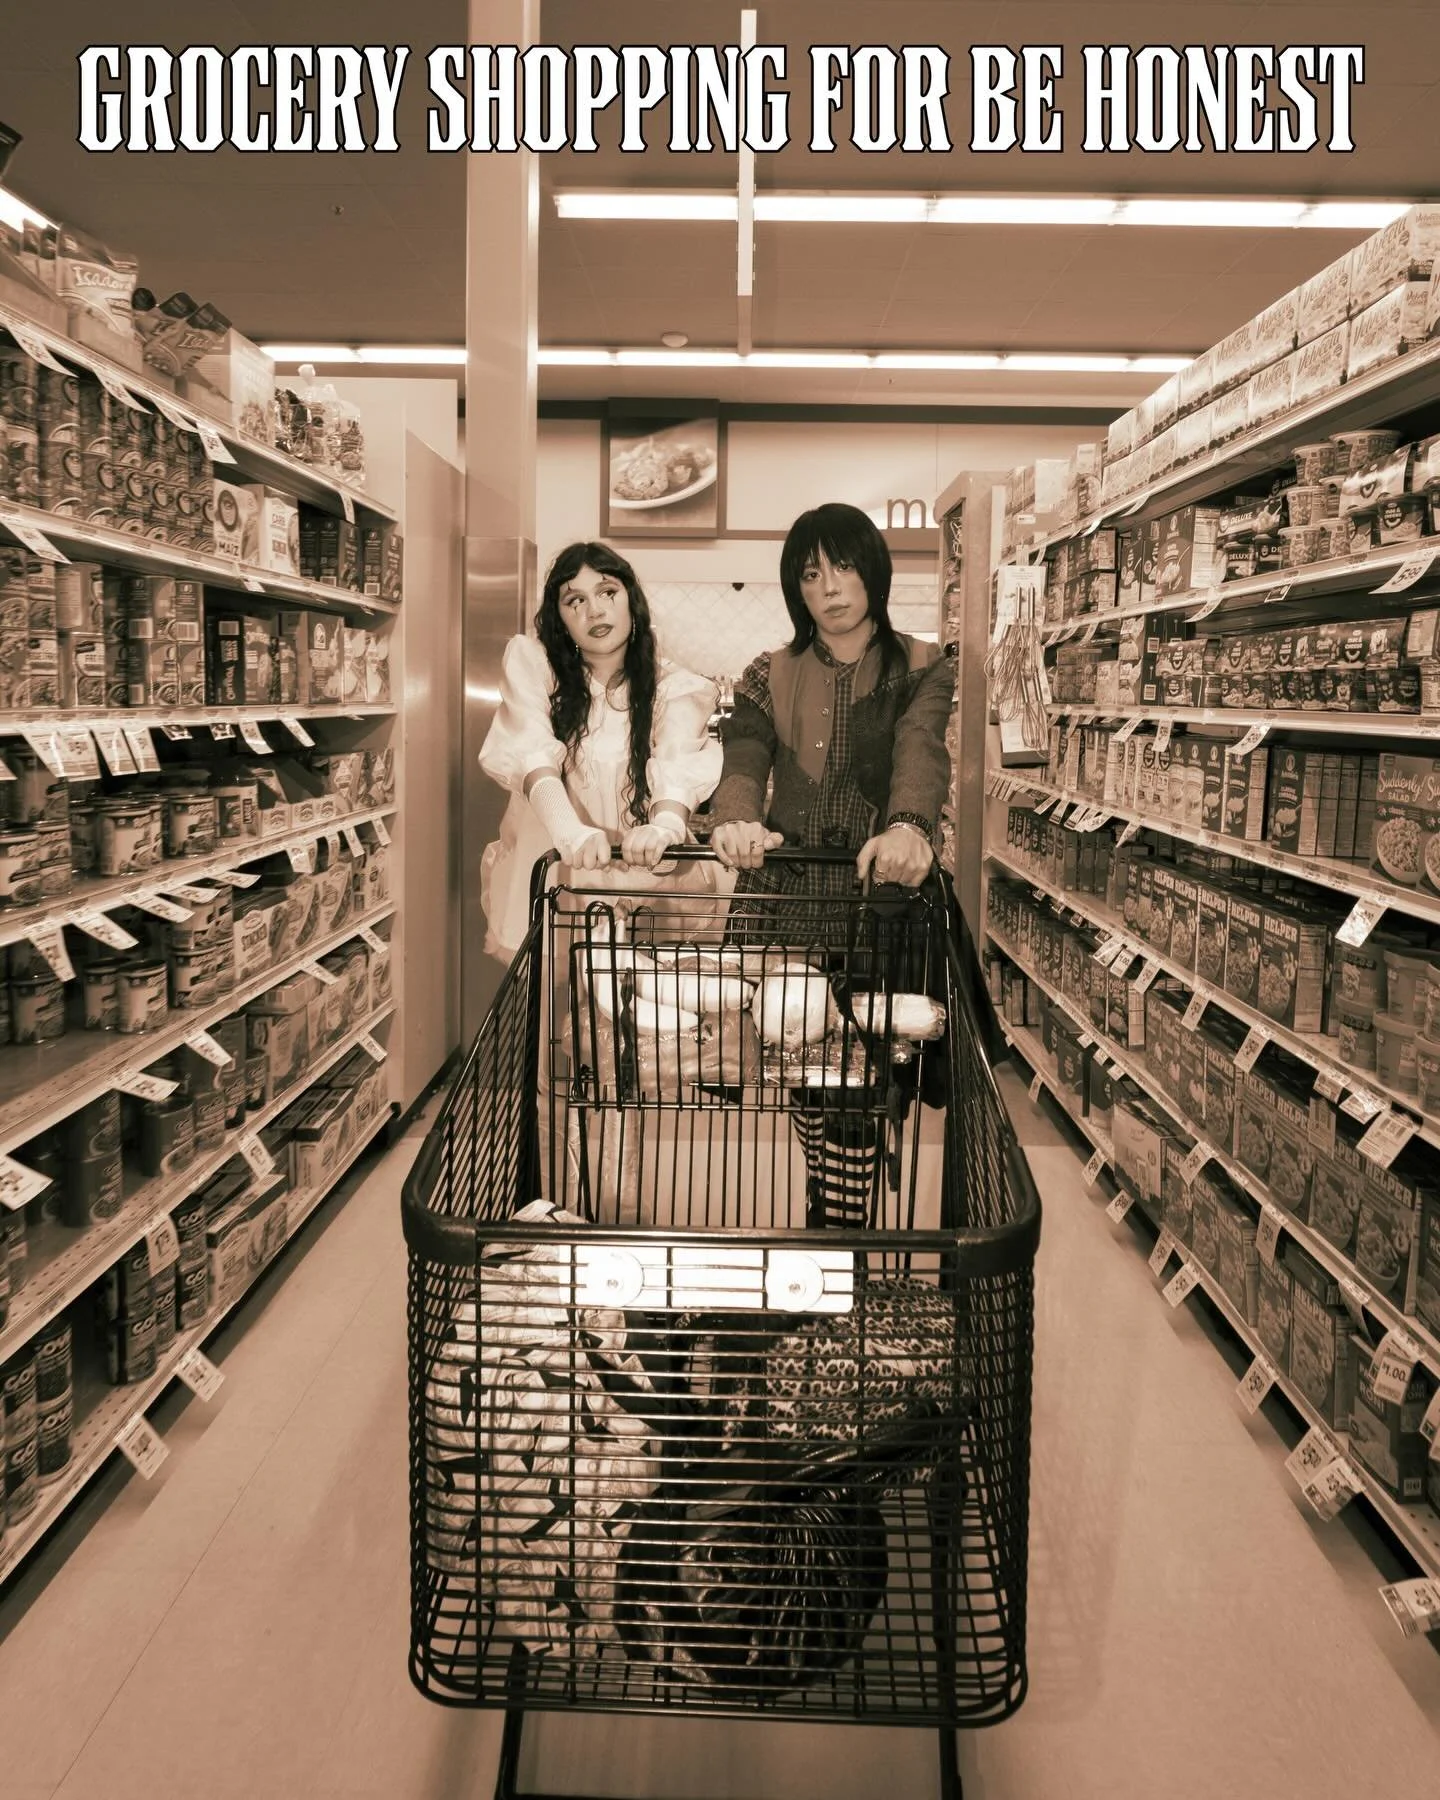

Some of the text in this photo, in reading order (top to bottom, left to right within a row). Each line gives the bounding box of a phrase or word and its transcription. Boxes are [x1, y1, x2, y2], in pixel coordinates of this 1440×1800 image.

[1378, 769, 1427, 803] Suddenly!
[1388, 792, 1410, 803] SALAD
[1201, 889, 1227, 913] HELPER
[1231, 901, 1260, 928] HELPER
[1264, 914, 1298, 943] HELPER
[1366, 1157, 1412, 1209] HELPER
